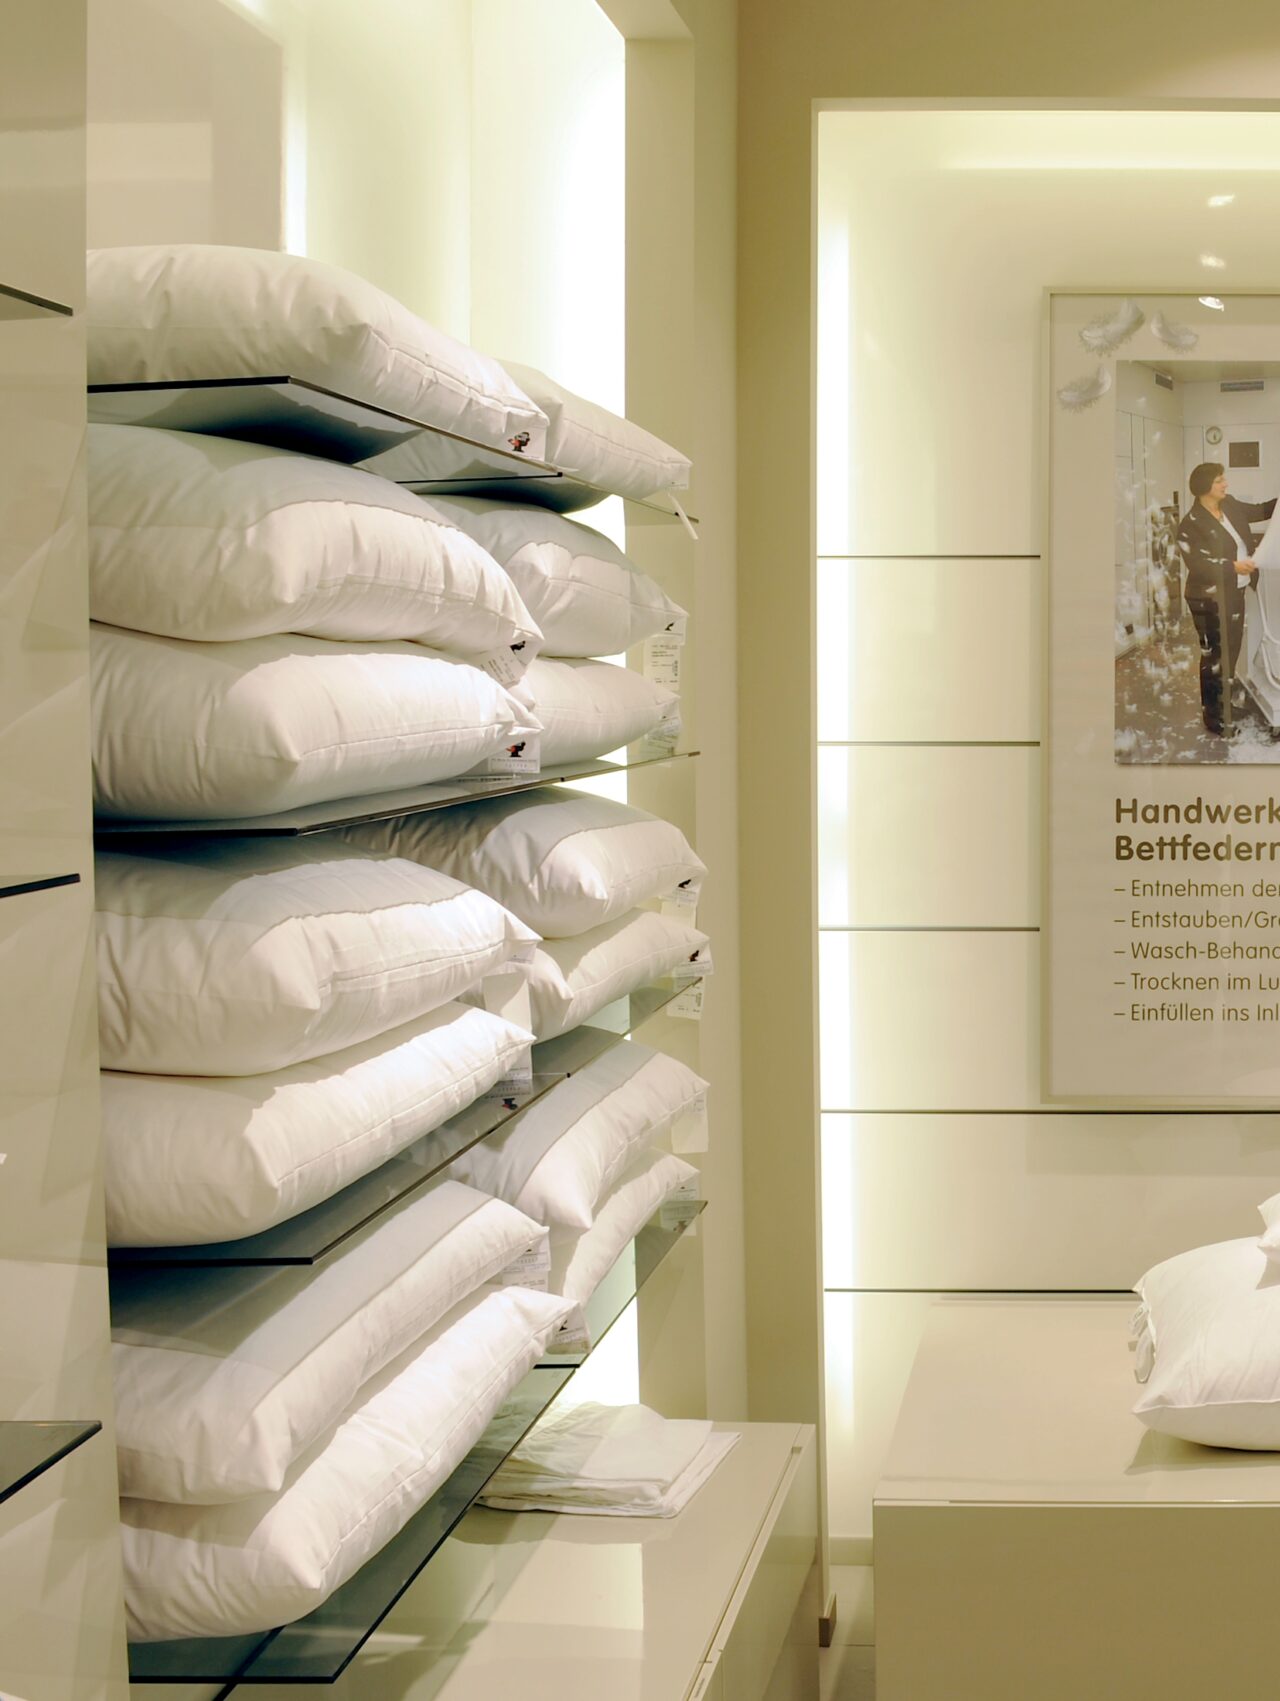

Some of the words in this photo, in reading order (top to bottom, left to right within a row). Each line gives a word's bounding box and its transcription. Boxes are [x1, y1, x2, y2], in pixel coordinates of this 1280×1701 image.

[1132, 879, 1243, 897] Entnehmen
[1131, 972, 1219, 990] Trocknen
[1228, 973, 1250, 990] im
[1132, 1003, 1213, 1021] Einfüllen
[1223, 1005, 1249, 1021] ins
